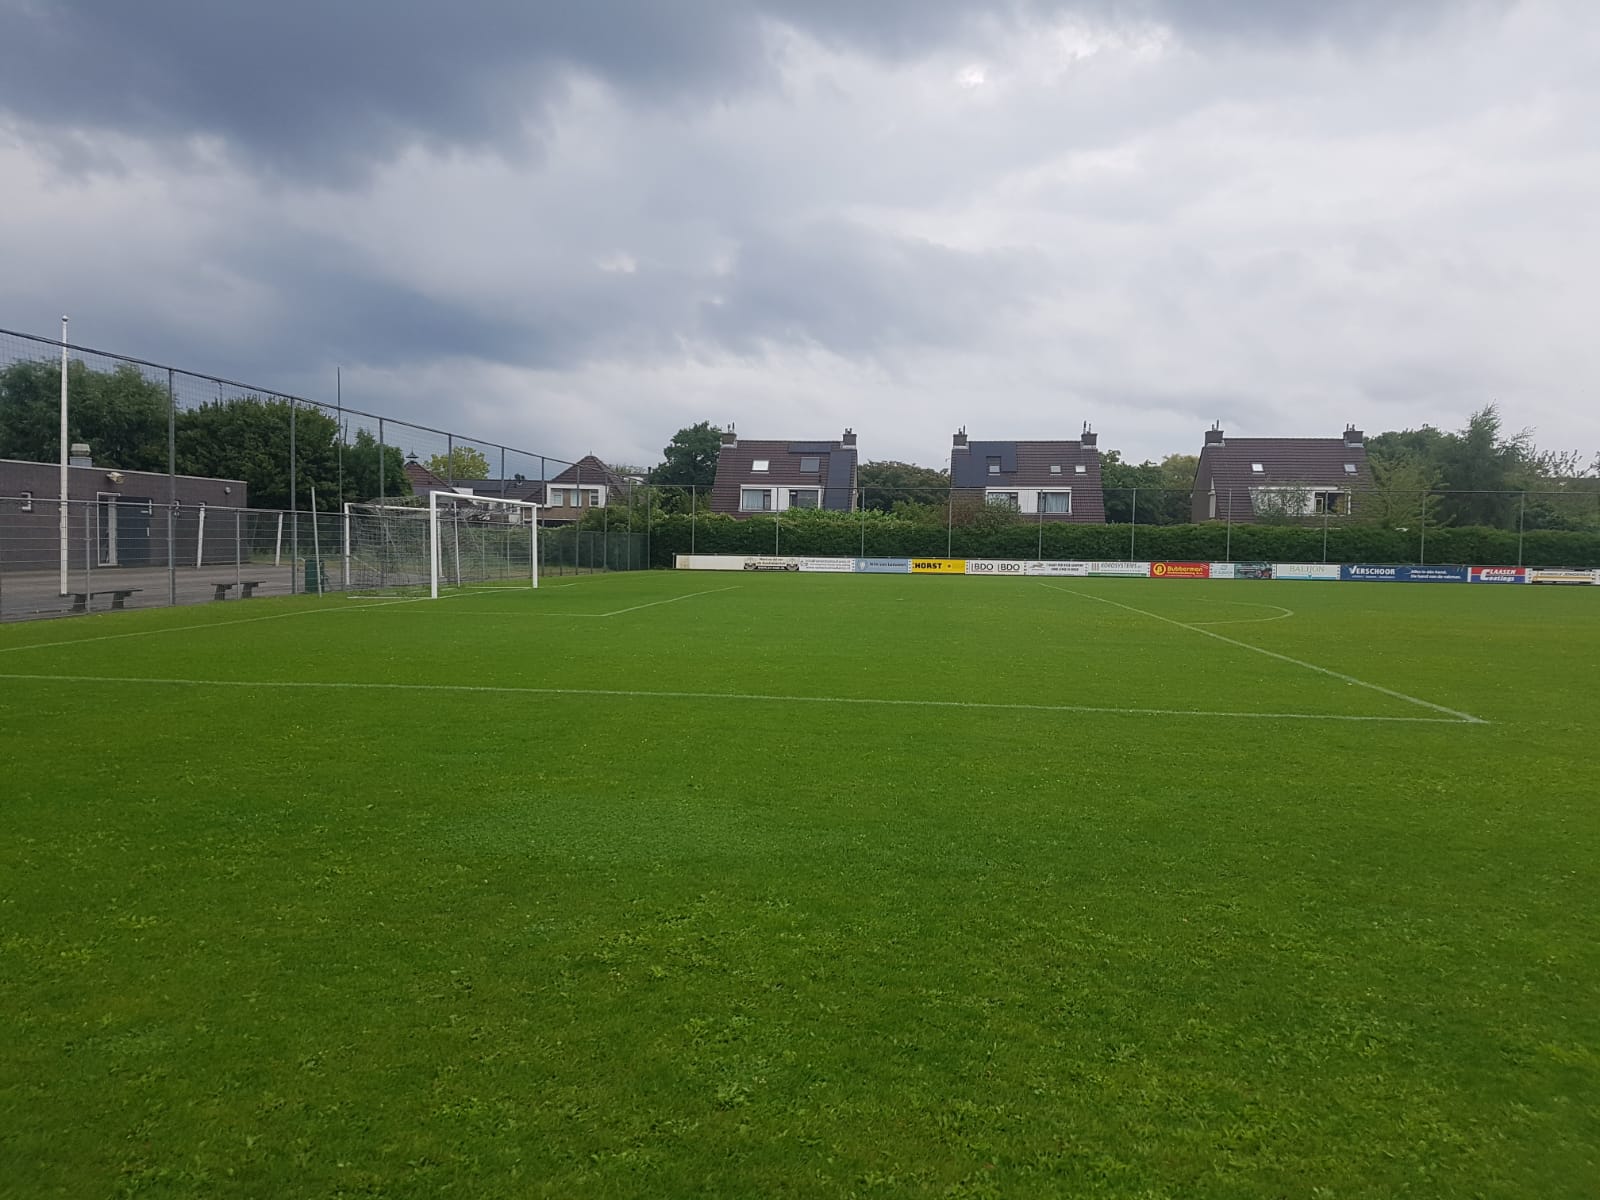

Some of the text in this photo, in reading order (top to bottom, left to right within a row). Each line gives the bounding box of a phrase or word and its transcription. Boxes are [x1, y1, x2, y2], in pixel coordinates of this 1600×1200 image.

[973, 563, 994, 571] BDO
[999, 563, 1020, 571] BDO
[1349, 566, 1395, 575] VERSCHOOR
